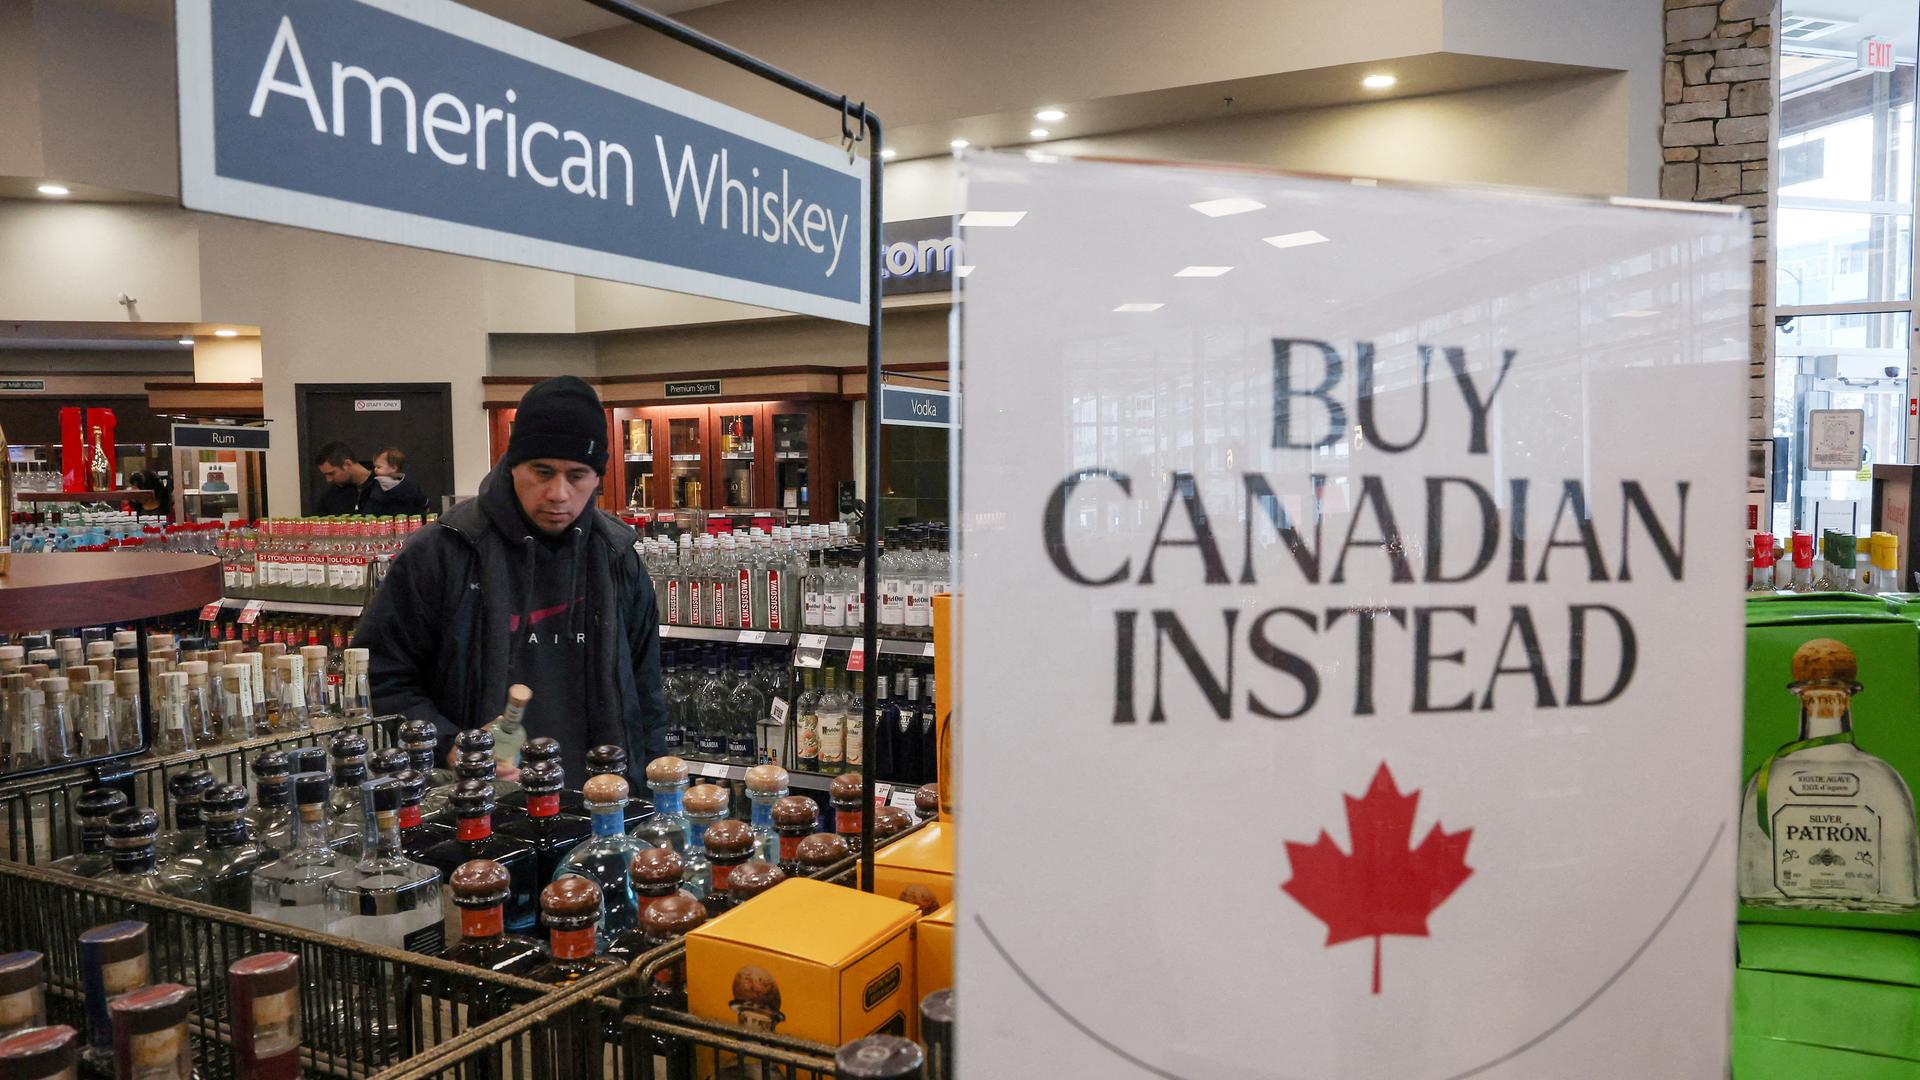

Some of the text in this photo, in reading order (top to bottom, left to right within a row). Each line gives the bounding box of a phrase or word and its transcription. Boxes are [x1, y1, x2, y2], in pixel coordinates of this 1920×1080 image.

[1868, 42, 1892, 67] EXIT
[249, 16, 849, 278] American Whiskey
[670, 384, 716, 393] Premium Spirits
[1271, 337, 1517, 454] BUY
[911, 399, 937, 416] Vodka
[212, 432, 235, 445] Rum
[1042, 469, 1691, 587] CANADIAN
[742, 578, 750, 622] LUKSUSOWA
[771, 579, 779, 623] LUKSUSOWA
[528, 632, 585, 644] AIR
[1113, 604, 1638, 724] INSTEAD
[1809, 815, 1842, 824] SILVER
